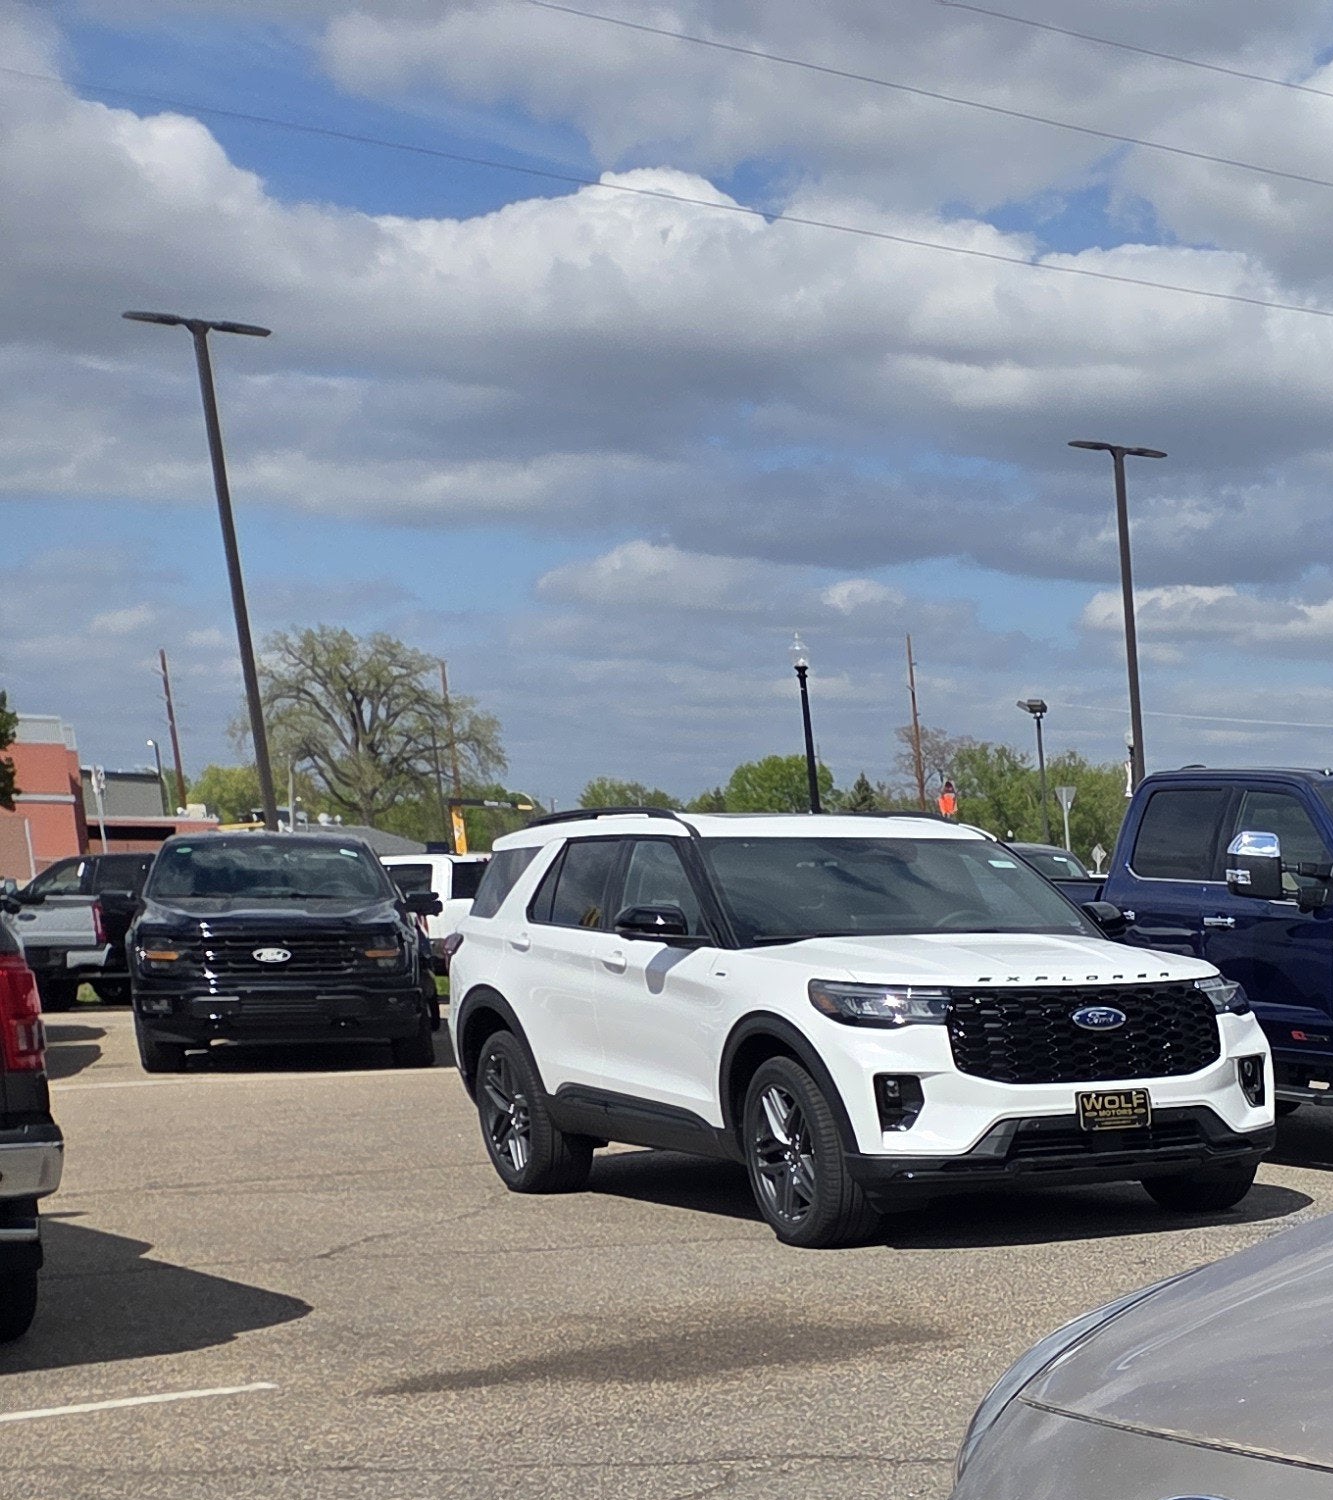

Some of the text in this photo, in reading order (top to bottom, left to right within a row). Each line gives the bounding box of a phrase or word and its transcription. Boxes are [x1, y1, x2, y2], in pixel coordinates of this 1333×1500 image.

[978, 972, 1169, 982] EXPLORER
[1087, 1011, 1115, 1024] Ford
[1083, 1093, 1145, 1110] WOLF
